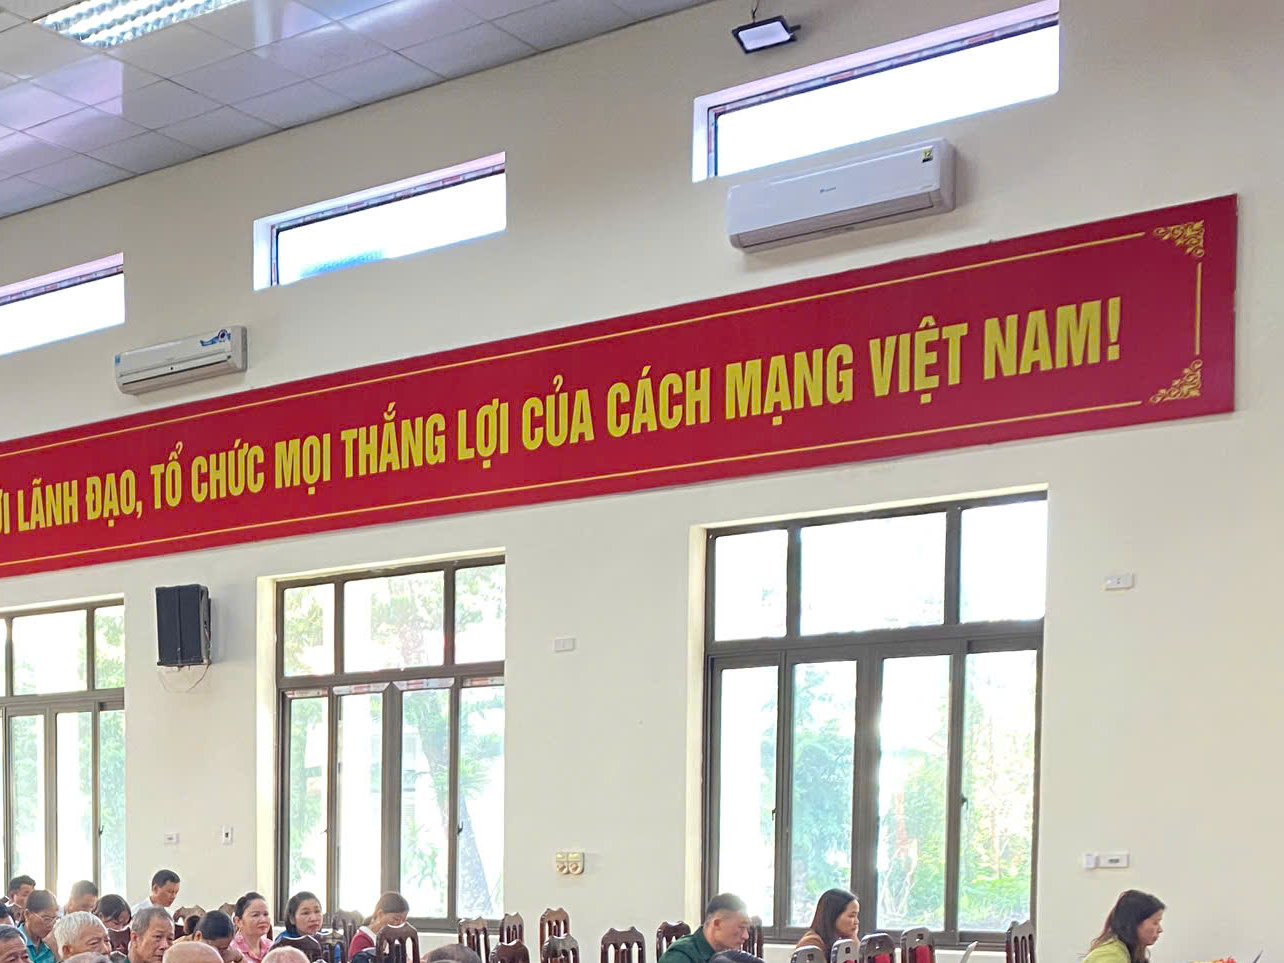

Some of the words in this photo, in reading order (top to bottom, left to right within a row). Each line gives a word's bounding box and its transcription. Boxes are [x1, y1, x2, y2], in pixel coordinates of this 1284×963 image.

[17, 478, 79, 532] LÃNH
[85, 469, 143, 528] ĐẠO,
[150, 441, 183, 510] TỔ
[191, 438, 265, 503] CHỨC
[275, 433, 331, 495] MỌI
[340, 401, 446, 478] THẮNG
[457, 398, 509, 469] LỢI
[521, 374, 595, 451] CỦA
[606, 365, 711, 438] CÁCH
[725, 343, 853, 427] MẠNG
[869, 316, 968, 404] VIỆT
[983, 296, 1121, 380] NAM!
